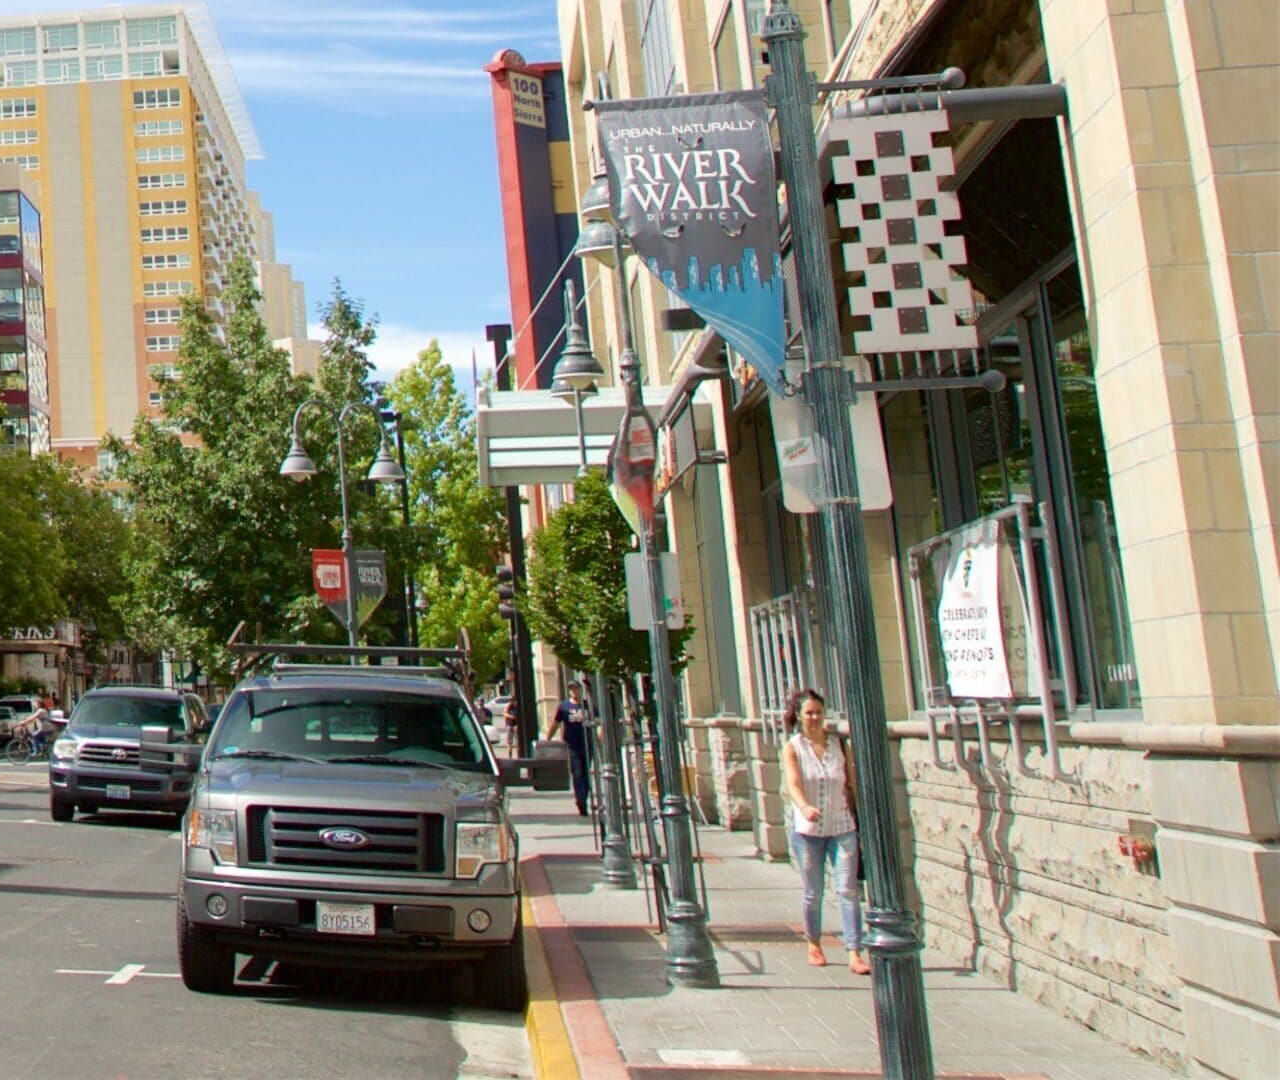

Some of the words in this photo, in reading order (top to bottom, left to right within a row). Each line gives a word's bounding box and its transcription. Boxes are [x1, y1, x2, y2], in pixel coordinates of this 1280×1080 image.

[513, 78, 538, 95] 100
[513, 94, 541, 108] North
[514, 107, 543, 122] Sierra
[623, 144, 656, 154] THE
[623, 149, 757, 185] RIVER
[627, 178, 758, 218] WALK
[646, 211, 740, 221] DISTRICT
[358, 566, 382, 579] RIVER
[359, 575, 383, 586] WALK
